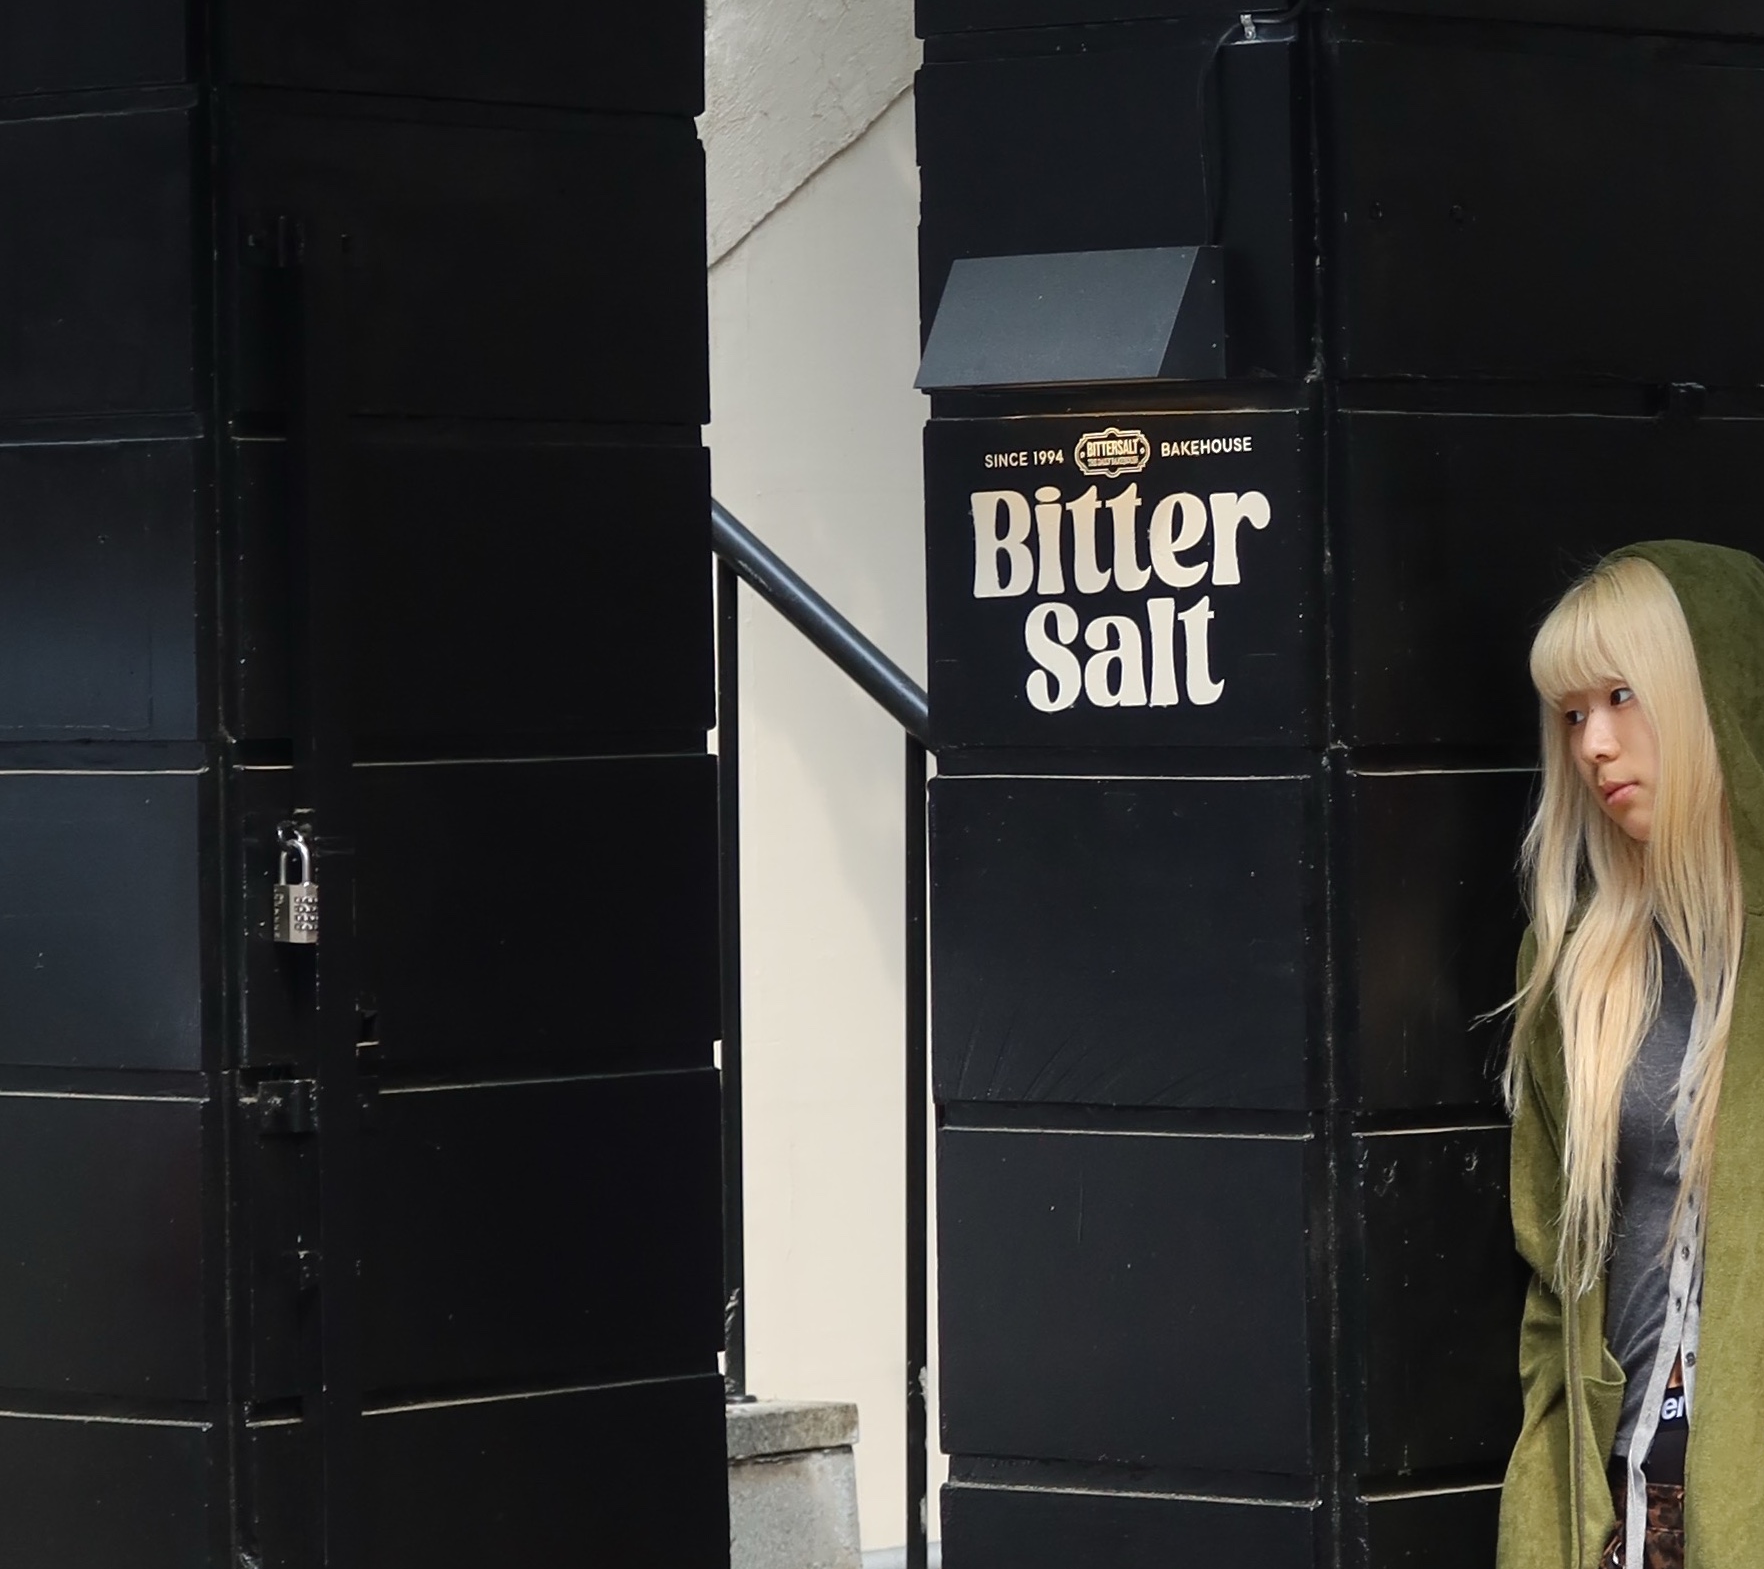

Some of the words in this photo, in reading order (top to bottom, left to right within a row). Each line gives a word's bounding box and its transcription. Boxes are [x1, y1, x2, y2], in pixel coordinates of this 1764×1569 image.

[1086, 438, 1139, 458] BITTERSALT
[1160, 436, 1252, 458] BAKEHOUSE
[984, 452, 1029, 469] SINCE
[1033, 449, 1065, 466] 1994
[970, 482, 1271, 599] Bitter
[1024, 595, 1225, 713] Salt
